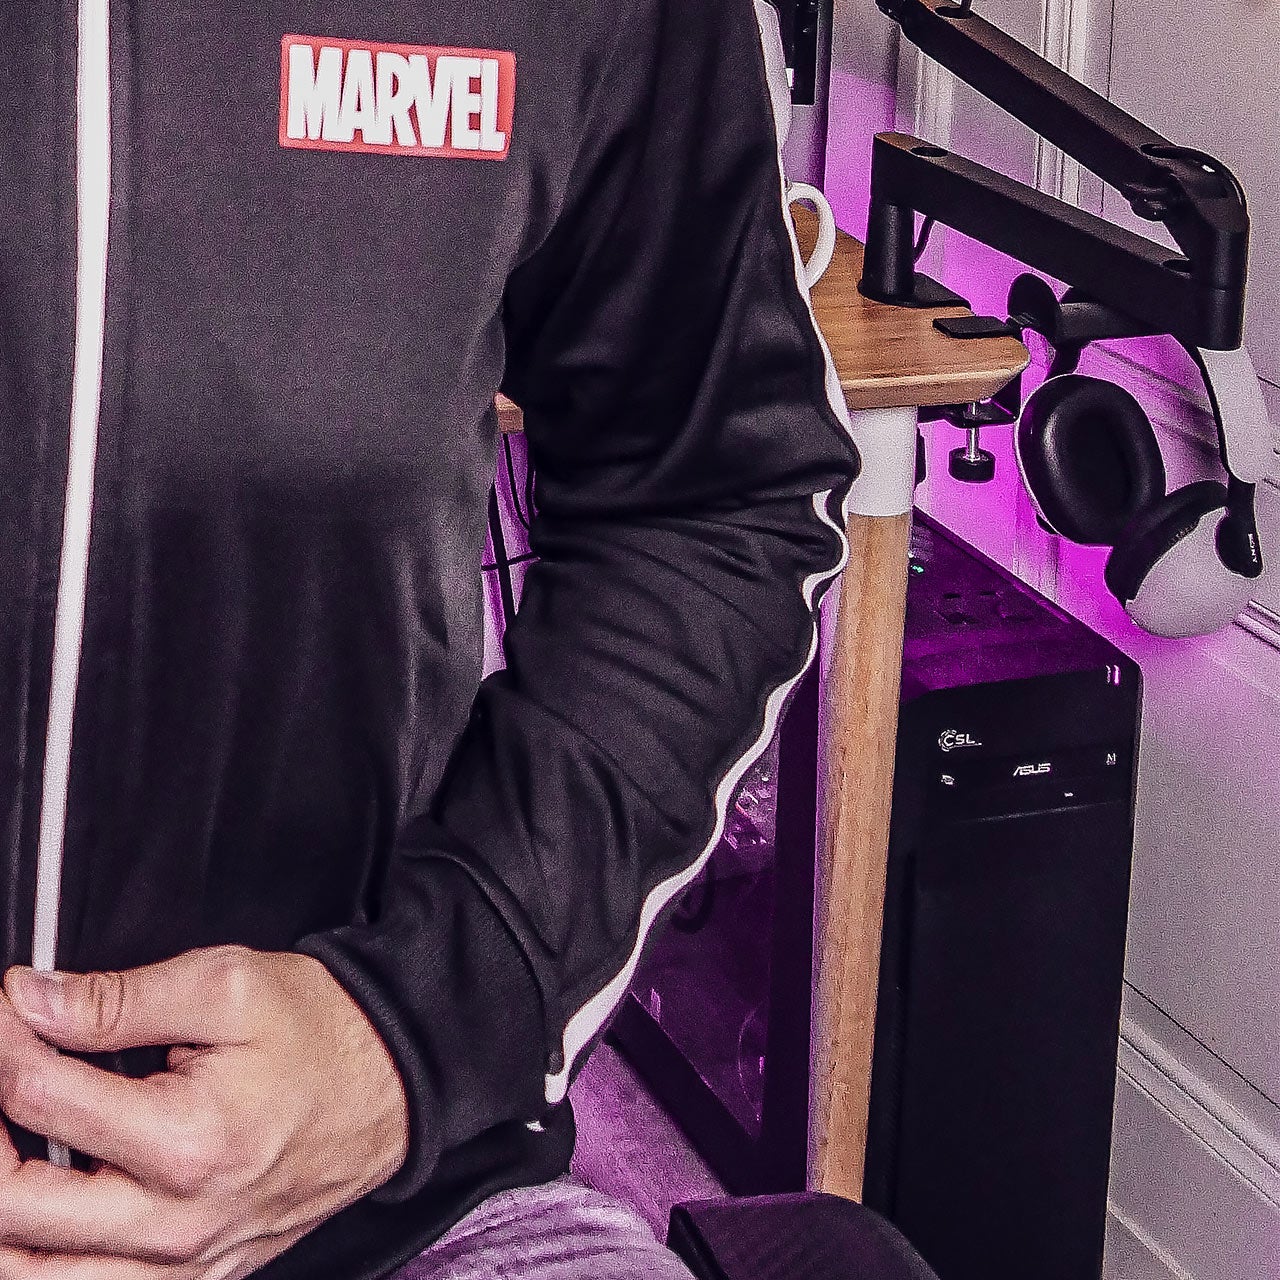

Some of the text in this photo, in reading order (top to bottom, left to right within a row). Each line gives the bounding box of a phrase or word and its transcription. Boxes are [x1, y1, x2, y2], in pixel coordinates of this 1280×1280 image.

[286, 43, 507, 152] MARVEL
[943, 733, 976, 747] CSL
[1013, 762, 1051, 777] ASUS
